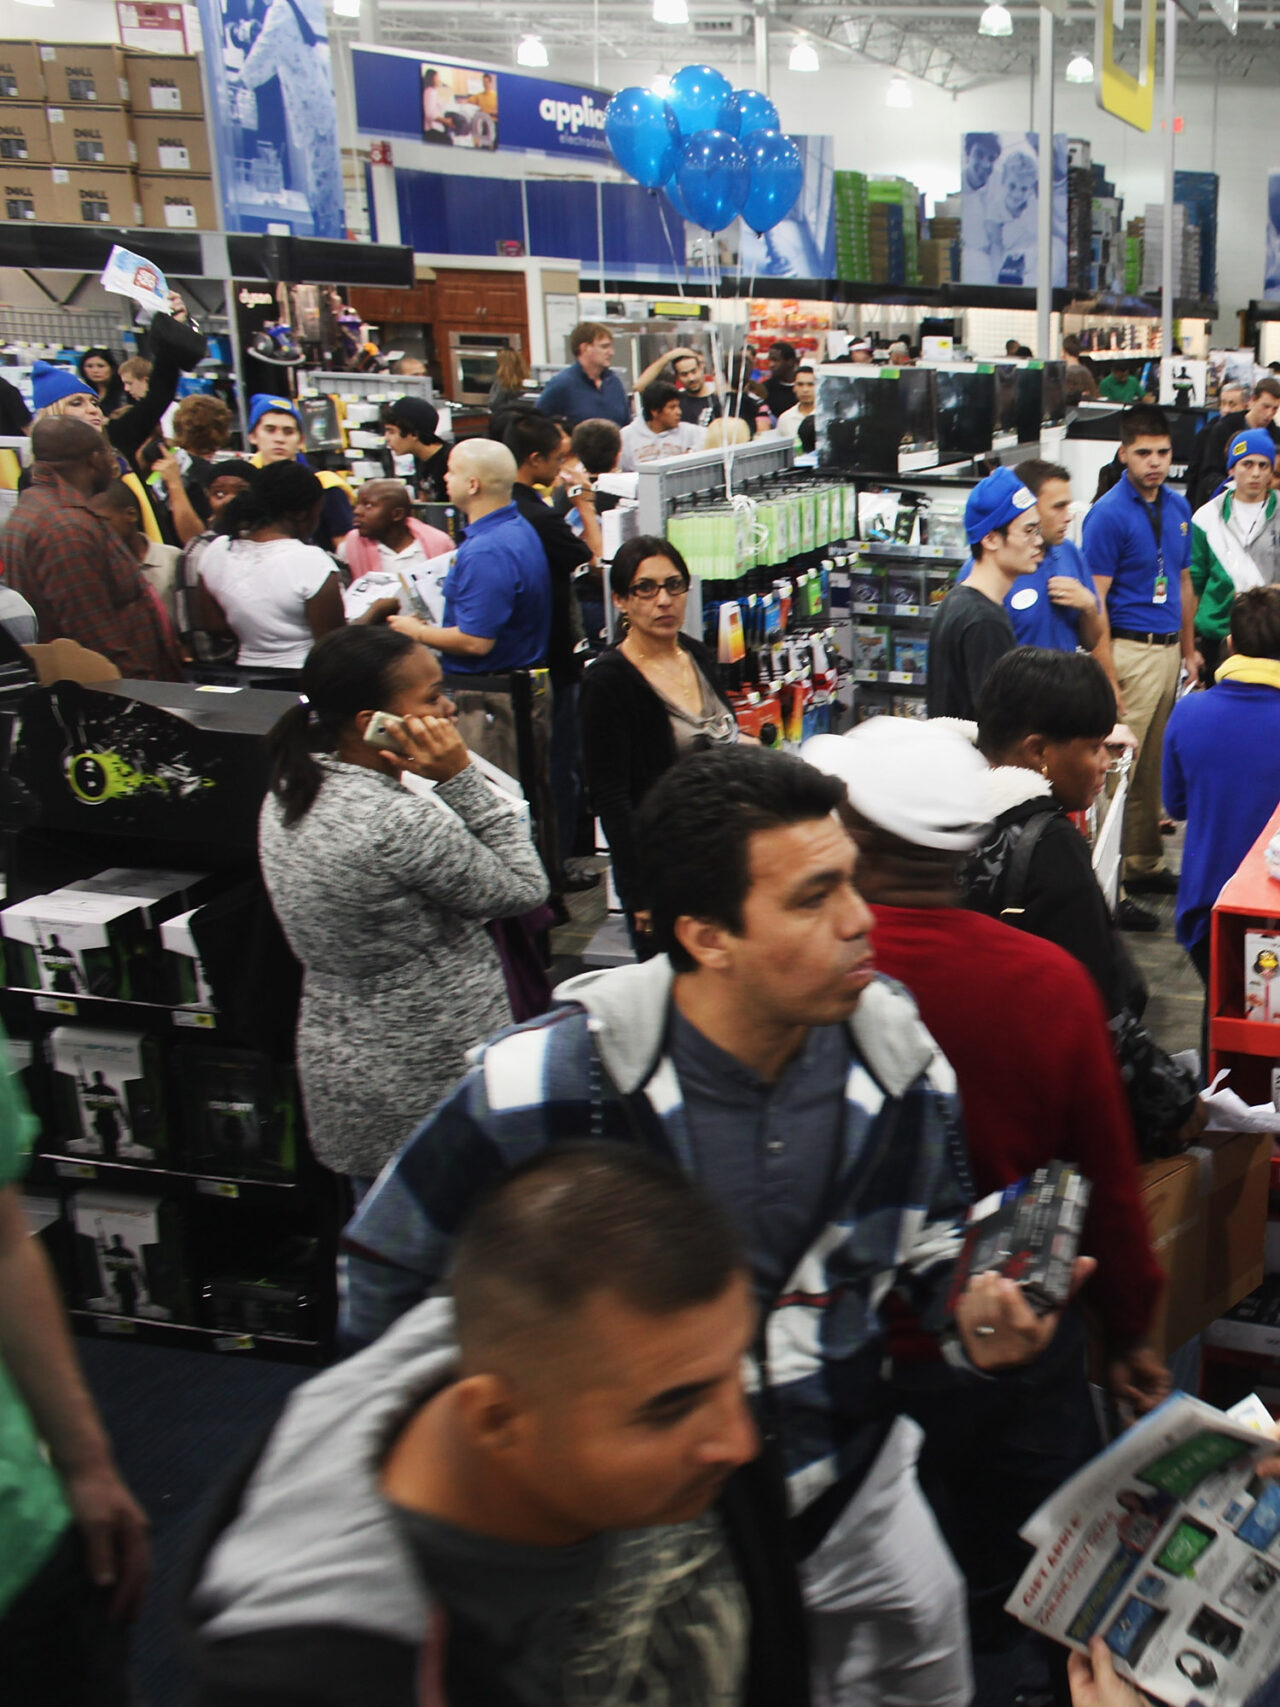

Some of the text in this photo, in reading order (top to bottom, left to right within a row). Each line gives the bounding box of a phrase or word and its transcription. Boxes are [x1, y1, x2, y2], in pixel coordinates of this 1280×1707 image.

[65, 66, 94, 77] DELL
[539, 95, 605, 133] applia
[73, 128, 102, 139] DELL
[5, 186, 33, 197] DELL
[78, 189, 107, 200] DELL
[1168, 464, 1189, 479] UT
